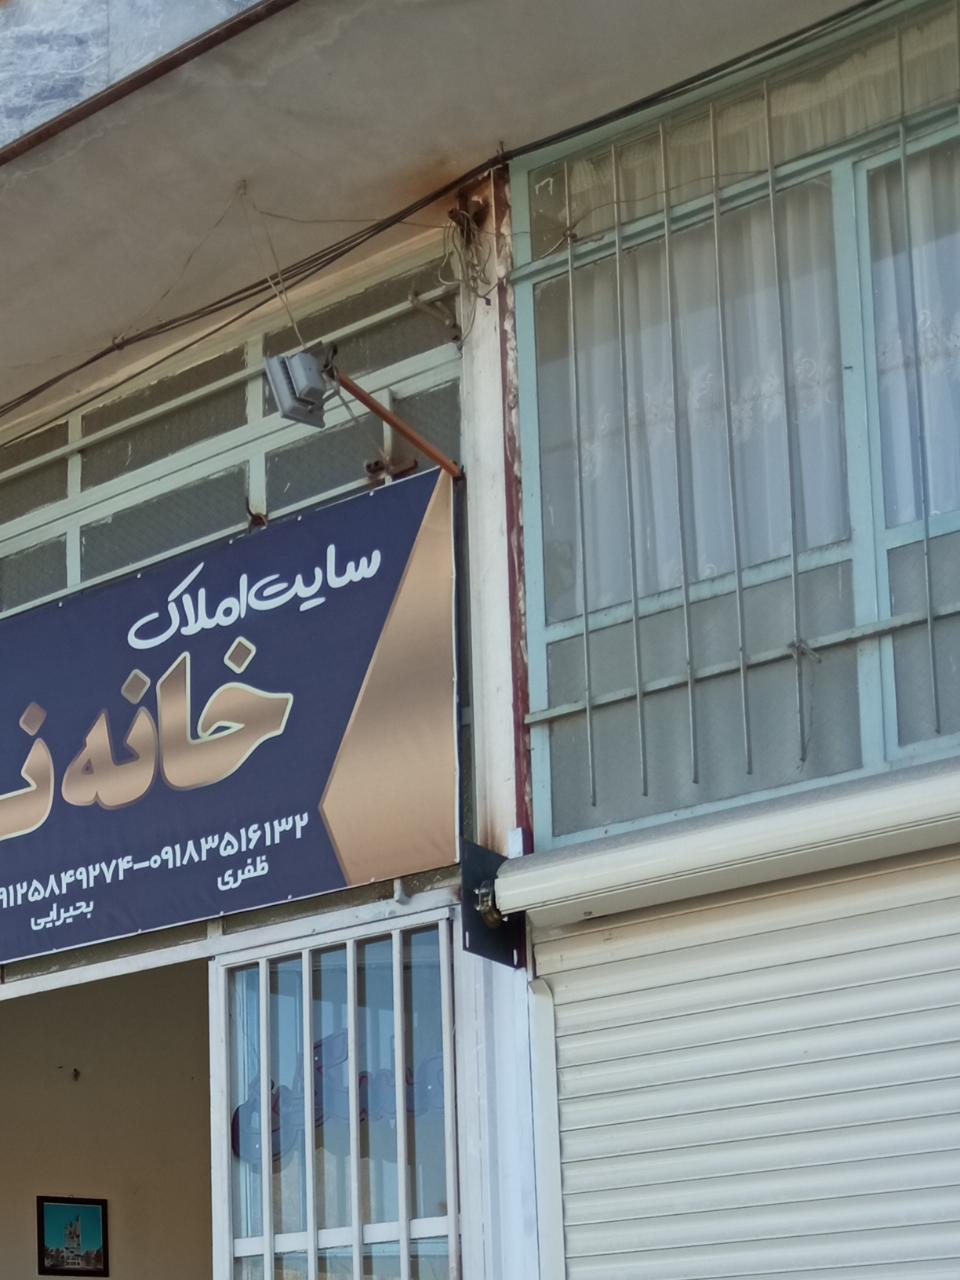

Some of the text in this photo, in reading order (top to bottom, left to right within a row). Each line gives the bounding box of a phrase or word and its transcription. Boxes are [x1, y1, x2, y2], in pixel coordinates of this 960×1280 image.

[127, 543, 382, 650] سایت املاک
[61, 635, 294, 810] خانه
[217, 855, 270, 892] ظفری
